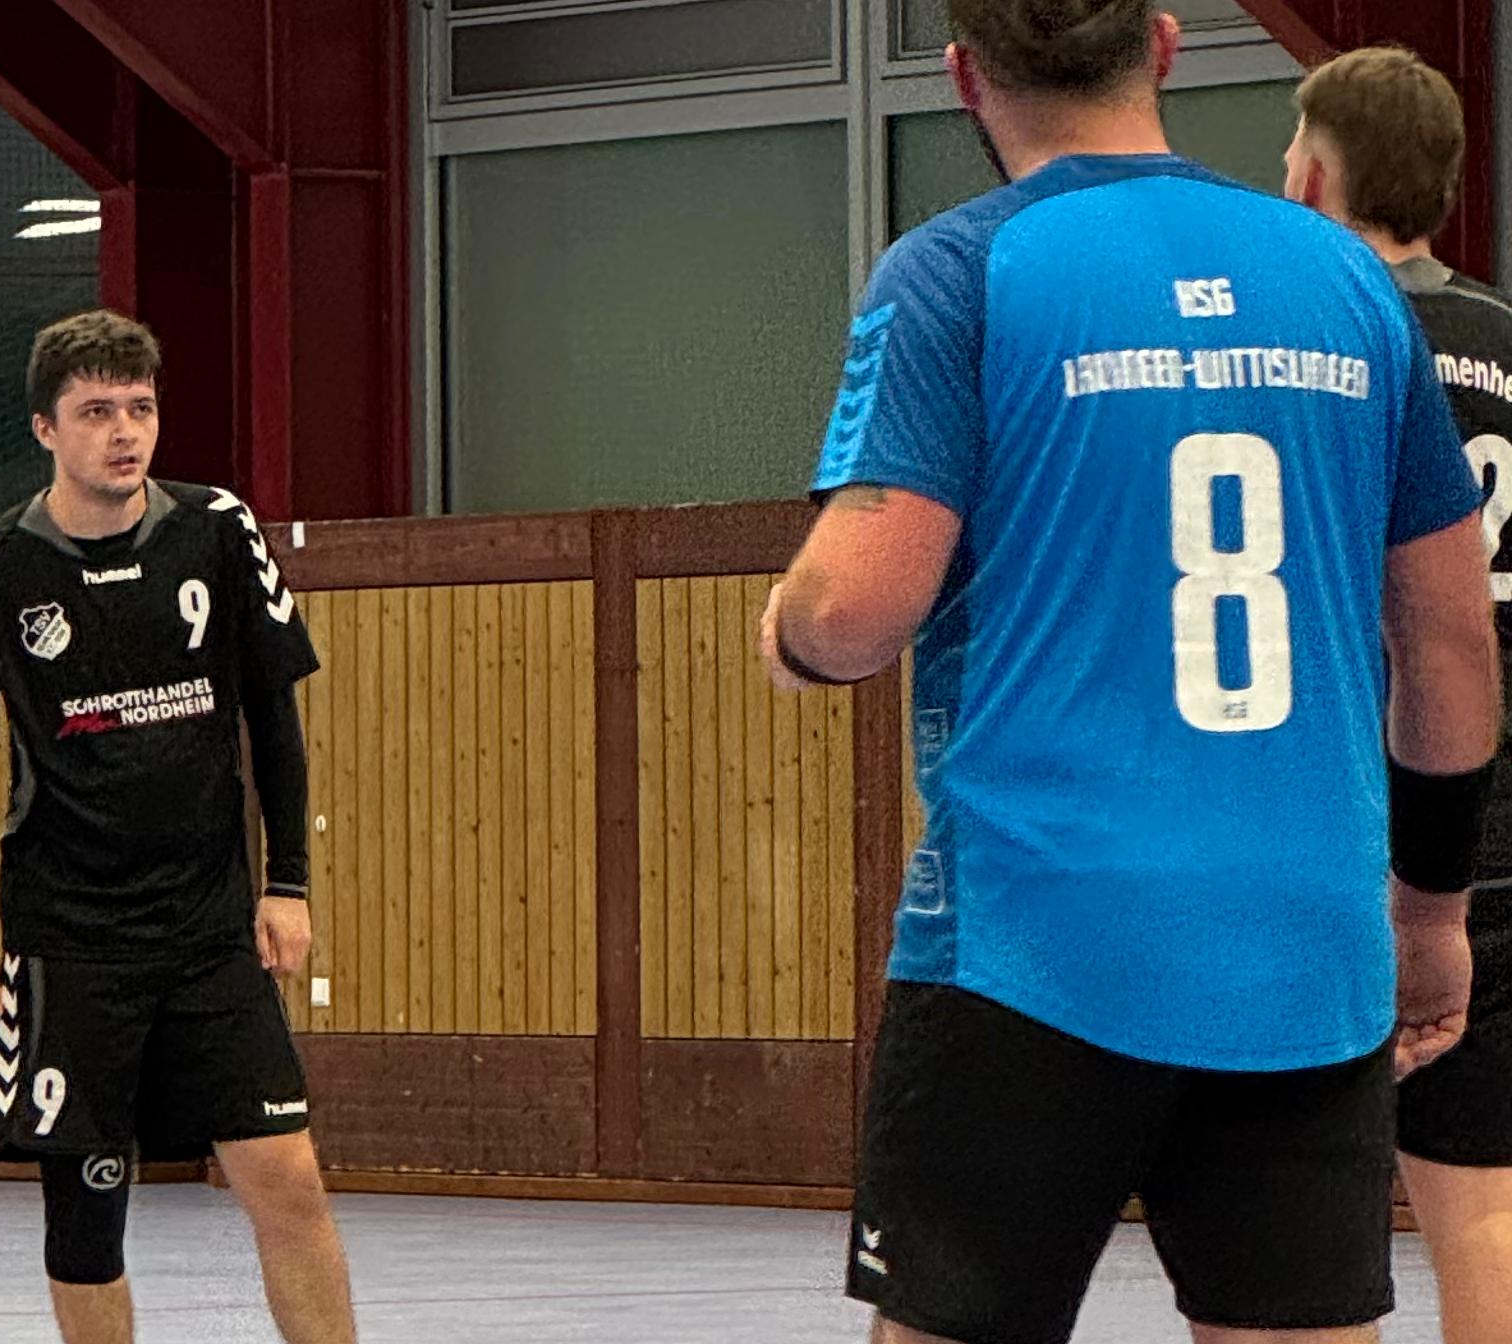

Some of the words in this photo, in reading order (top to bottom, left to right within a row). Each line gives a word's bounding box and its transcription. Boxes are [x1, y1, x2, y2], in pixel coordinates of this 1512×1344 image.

[177, 579, 211, 650] 9
[1169, 432, 1293, 733] 8
[61, 676, 214, 718] SCHROTTHANDEL
[119, 693, 216, 726] NORDHEIM
[32, 1067, 67, 1137] 9
